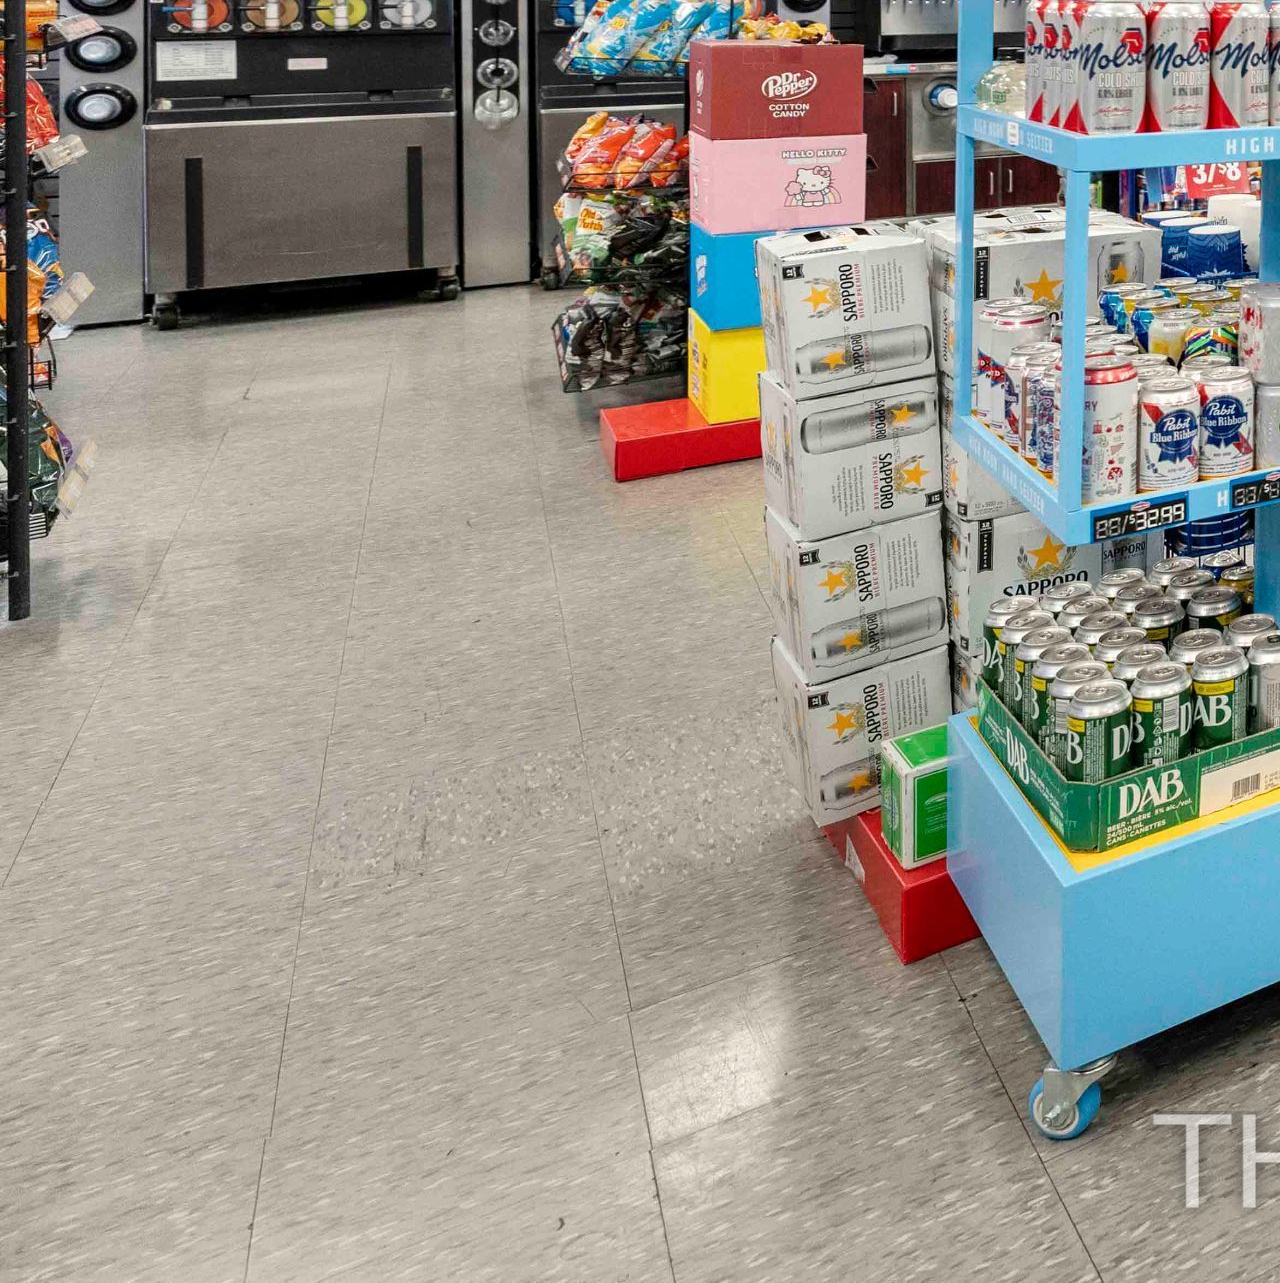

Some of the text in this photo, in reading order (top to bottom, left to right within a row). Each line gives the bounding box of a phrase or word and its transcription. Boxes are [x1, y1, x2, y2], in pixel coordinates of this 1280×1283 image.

[768, 75, 813, 98] Pepper
[780, 71, 802, 86] Dr
[768, 103, 810, 111] COTTON
[772, 110, 806, 118] CANDY
[781, 148, 847, 159] HELLO KITTY
[1026, 134, 1054, 154] SELTZER
[1226, 136, 1274, 156] HIGH
[838, 263, 859, 322] SAPPORO
[853, 333, 866, 375] SAPPORO
[873, 399, 888, 441] SAPPORO
[1208, 403, 1236, 416] Pabst
[1218, 414, 1247, 427] Ribbon
[1151, 427, 1199, 444] Blue Ribbon
[1164, 416, 1191, 432] Pabst
[878, 452, 895, 511] SAPPORO
[1020, 480, 1045, 514] SELTZER
[1104, 540, 1147, 561] SAPPORO
[854, 544, 873, 603] SAPPORO
[868, 611, 881, 655] SAPPORO
[863, 683, 883, 743] SAPPORO
[1006, 726, 1030, 785] DAB
[1118, 768, 1185, 820] DAB
[1107, 821, 1127, 833] BEER
[1154, 807, 1165, 816] 5%
[1132, 821, 1144, 831] mL
[1106, 819, 1167, 847] CANS CANETTES
